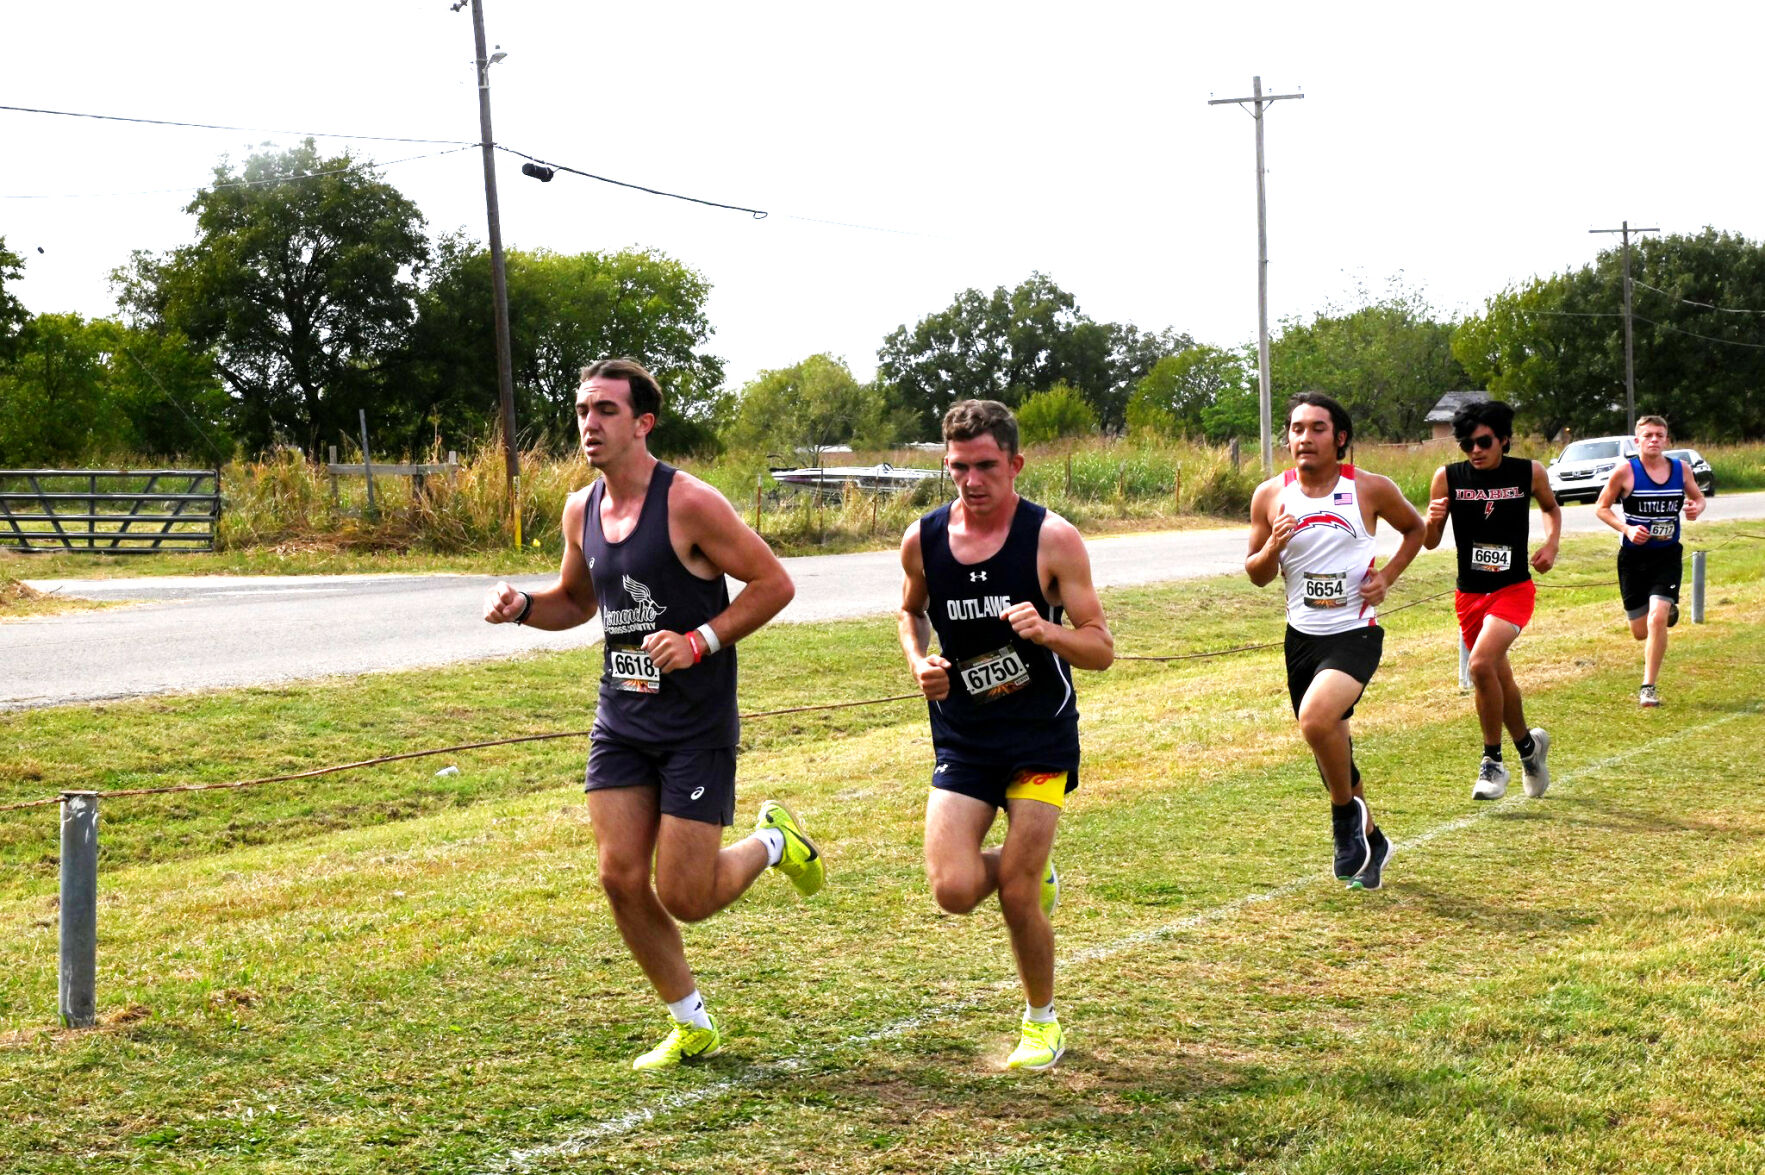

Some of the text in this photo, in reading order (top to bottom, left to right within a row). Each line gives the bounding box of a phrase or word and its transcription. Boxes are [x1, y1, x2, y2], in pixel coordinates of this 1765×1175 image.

[1455, 487, 1525, 501] IDABEL
[1638, 500, 1665, 513] LITTLE
[1475, 550, 1508, 565] 6694
[1306, 580, 1344, 597] 6654
[615, 654, 655, 677] 6618
[967, 657, 1019, 690] 6750
